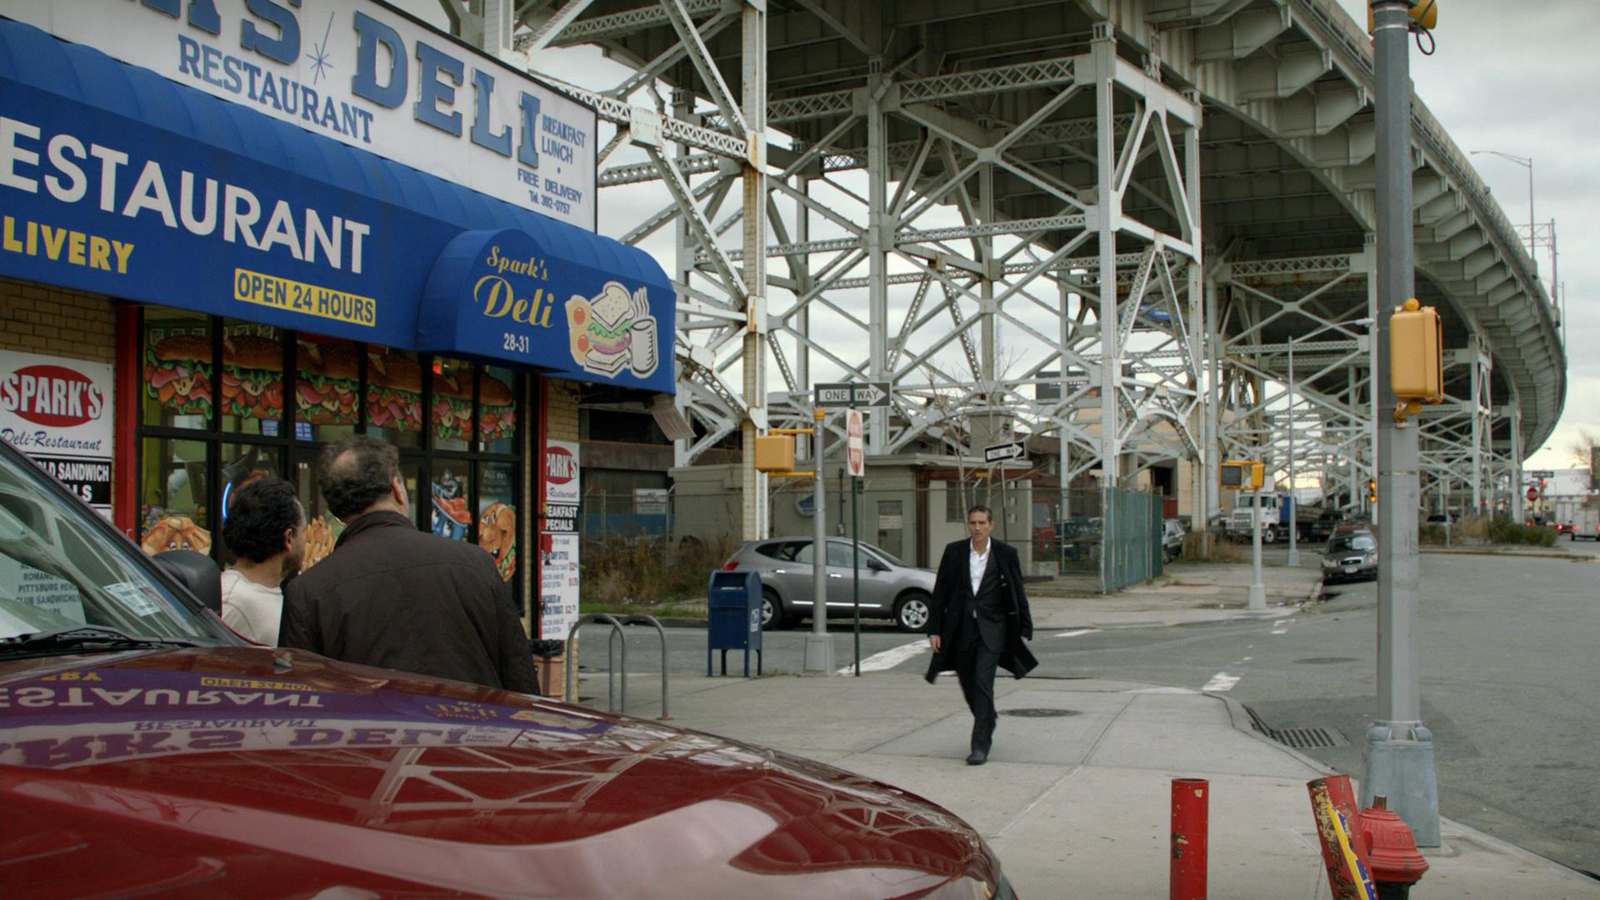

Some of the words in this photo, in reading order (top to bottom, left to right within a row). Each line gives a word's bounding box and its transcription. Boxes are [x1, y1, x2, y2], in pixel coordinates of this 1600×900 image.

[178, 34, 374, 144] RESTAURANT
[352, 10, 541, 169] DELI
[542, 114, 586, 148] BREAKFAST
[541, 135, 573, 164] LUNCH
[0, 116, 370, 274] ESTAURANT
[517, 168, 539, 188] FREE
[545, 178, 582, 204] DELIVERY
[3, 215, 134, 274] LIVERY
[486, 246, 548, 281] Spark's
[237, 273, 286, 306] OPEN
[293, 284, 312, 311] 24
[318, 291, 374, 323] HOURS
[473, 274, 554, 328] Deli
[503, 333, 530, 353] 28-31
[2, 371, 102, 420] SPARK'S
[824, 390, 847, 401] ONE
[856, 390, 880, 401] WAY
[58, 462, 110, 483] SANDWICH
[546, 505, 578, 518] EAKFAST
